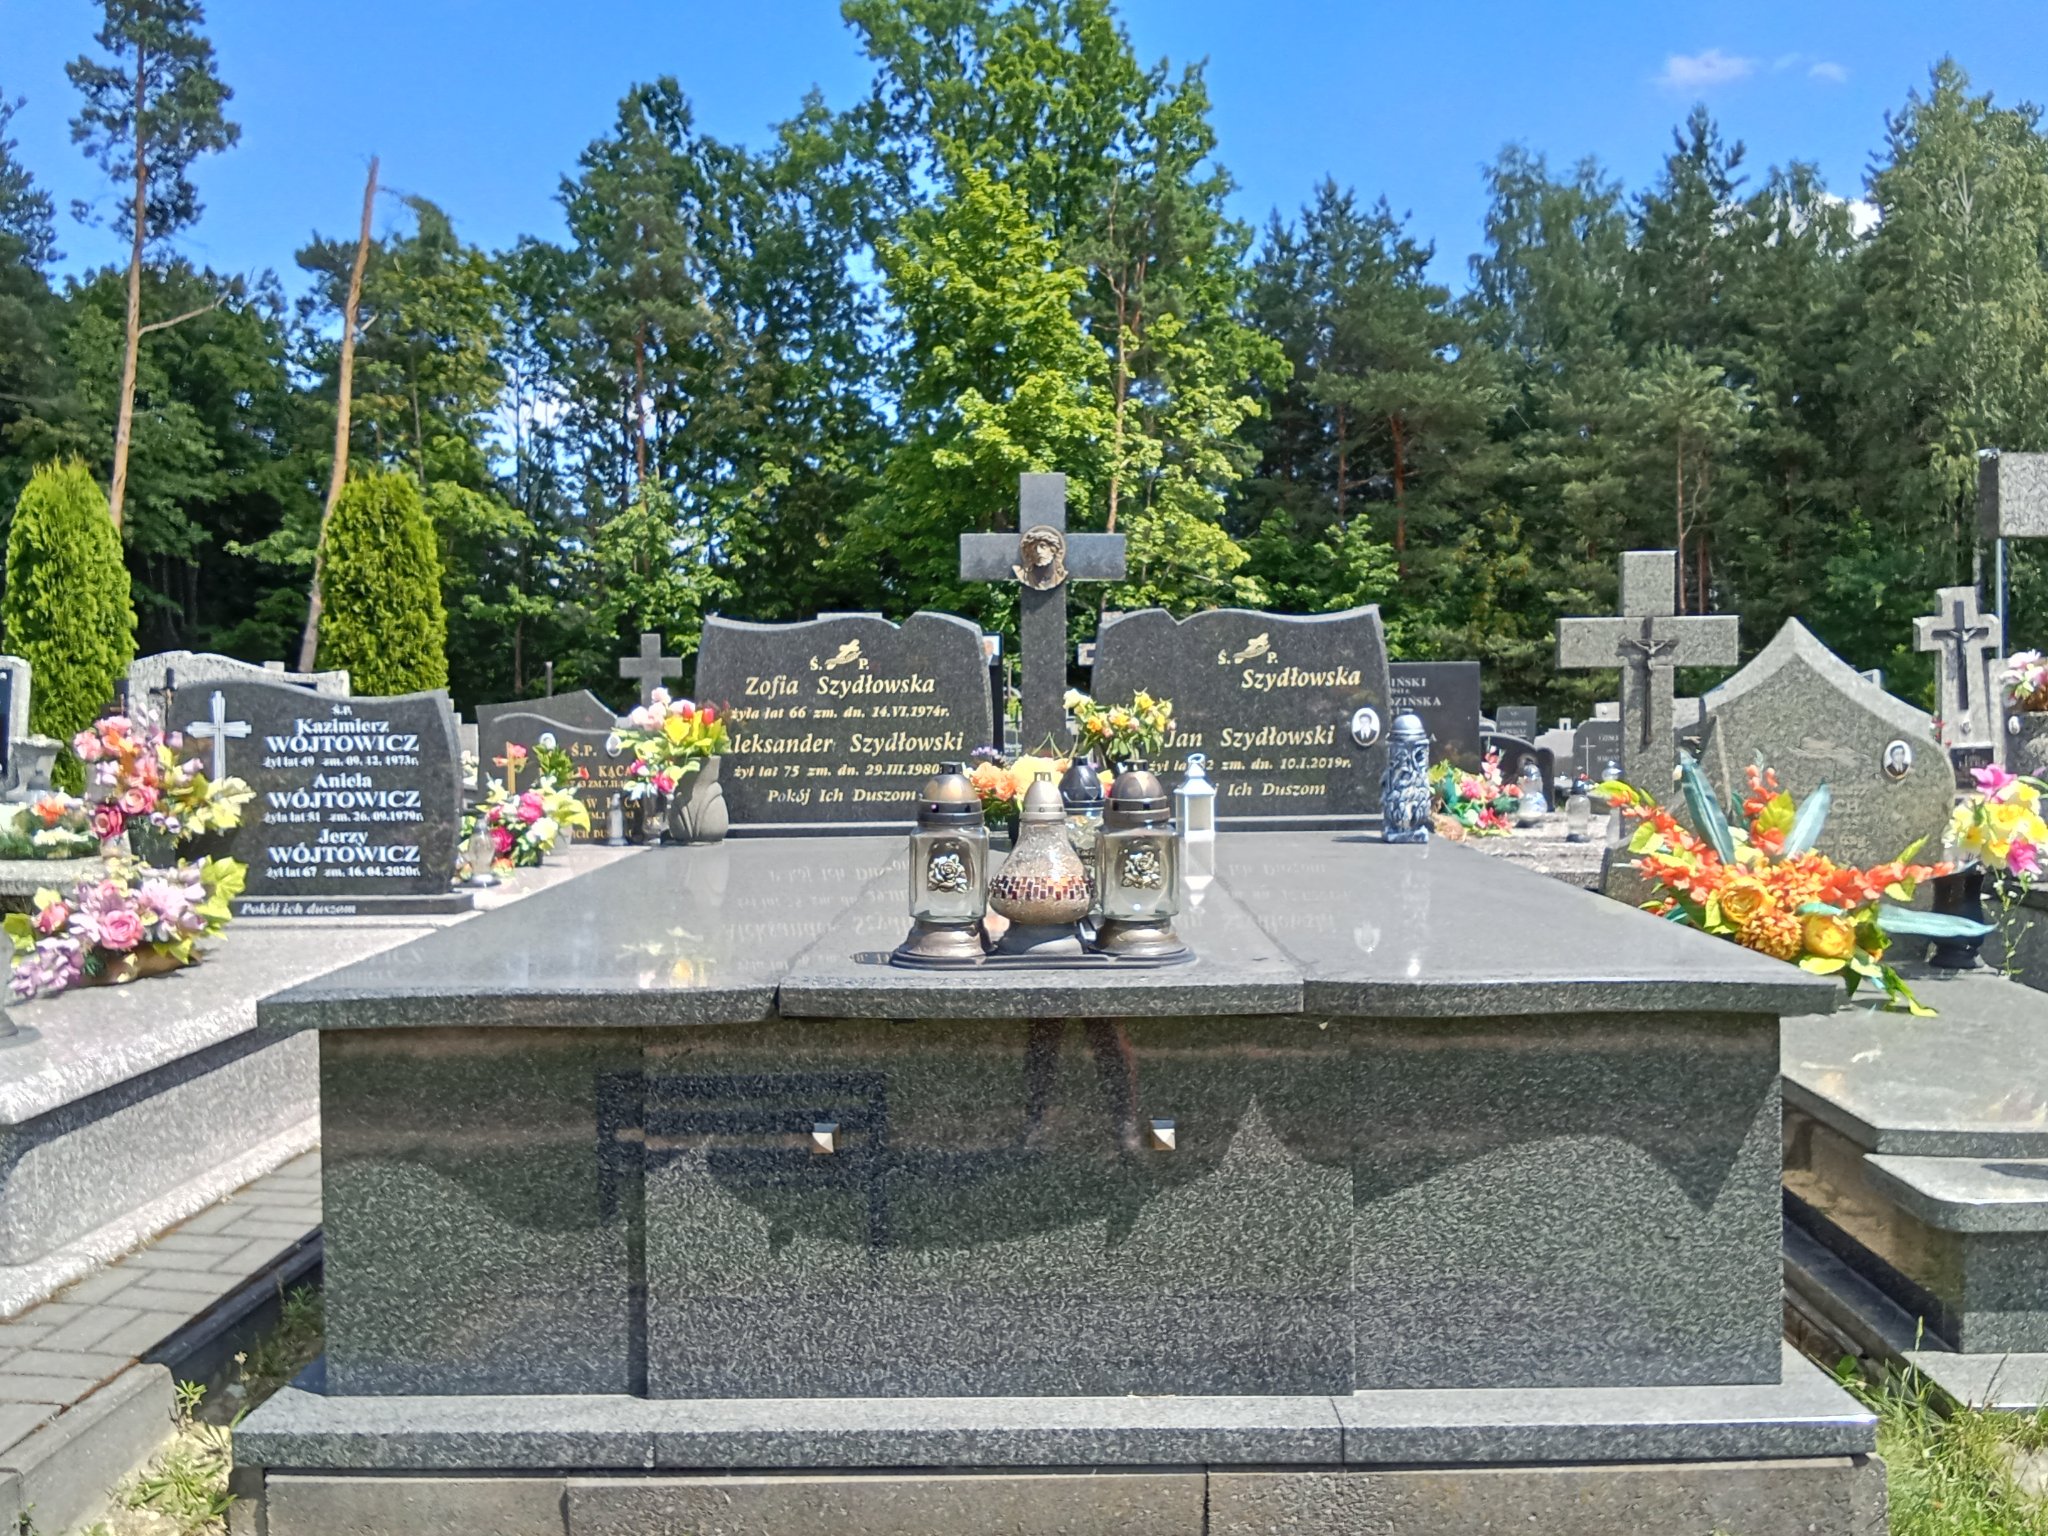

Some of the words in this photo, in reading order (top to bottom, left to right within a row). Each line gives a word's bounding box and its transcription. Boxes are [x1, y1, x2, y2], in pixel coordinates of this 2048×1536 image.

[1241, 665, 1361, 692] Szydłowska
[745, 675, 799, 700] Zofia
[816, 674, 935, 699] Szydłowska
[764, 707, 784, 719] lat
[789, 705, 807, 719] 66
[813, 708, 838, 719] zm.
[843, 706, 866, 718] dn.
[871, 705, 950, 718] 14.VI.1974r.
[296, 718, 390, 735] Kazimierz
[264, 733, 420, 753] WÓJTOWICZ
[730, 733, 834, 755] leksander
[849, 731, 964, 757] Szydłowski
[1164, 730, 1202, 748] Jan
[1220, 725, 1335, 751] Szydłowski
[571, 742, 598, 757] Ś.P.
[283, 756, 299, 767] lat
[300, 756, 315, 767] 49
[321, 757, 344, 767] zm.
[1173, 759, 1187, 771] la
[1221, 760, 1246, 771] zm.
[1251, 758, 1274, 770] dn.
[1280, 758, 1352, 770] 10.I.2019r.
[758, 765, 779, 777] lat
[784, 765, 800, 777] 75
[807, 767, 832, 777] zm.
[837, 764, 860, 776] dn.
[313, 773, 372, 789] Aniela
[267, 787, 422, 808] WÓJTOWICZ
[768, 788, 811, 806] Pokój
[819, 788, 844, 803] Ich
[852, 788, 916, 802] Duszom
[1228, 784, 1252, 797] Ich
[1262, 783, 1326, 797] Duszom
[289, 811, 306, 823] lat
[328, 812, 351, 822] zm.
[317, 829, 369, 847] Jerzy
[268, 842, 421, 864] WÓJTOWICZ
[286, 866, 300, 878] lat
[301, 866, 318, 878] 67
[323, 868, 346, 878] zm.
[239, 902, 281, 917] Pokój
[282, 903, 304, 916] ich
[306, 902, 357, 916] duszom
